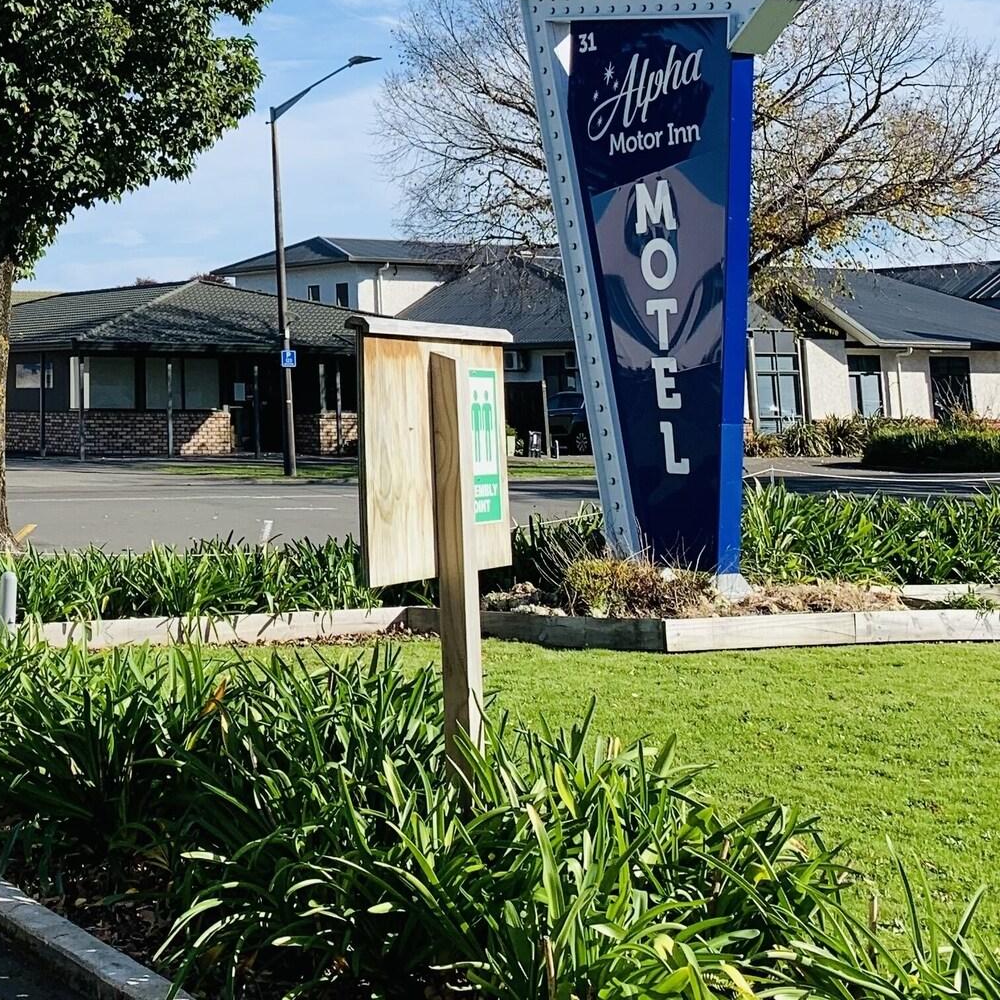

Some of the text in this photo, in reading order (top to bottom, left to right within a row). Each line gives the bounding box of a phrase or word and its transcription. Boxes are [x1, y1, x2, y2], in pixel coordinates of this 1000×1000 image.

[578, 32, 597, 53] 31
[587, 45, 703, 141] Alpha
[608, 122, 701, 156] Motor Inn
[635, 179, 690, 475] MOTEL
[474, 483, 498, 498] EMBLY
[473, 499, 491, 513] OINT
